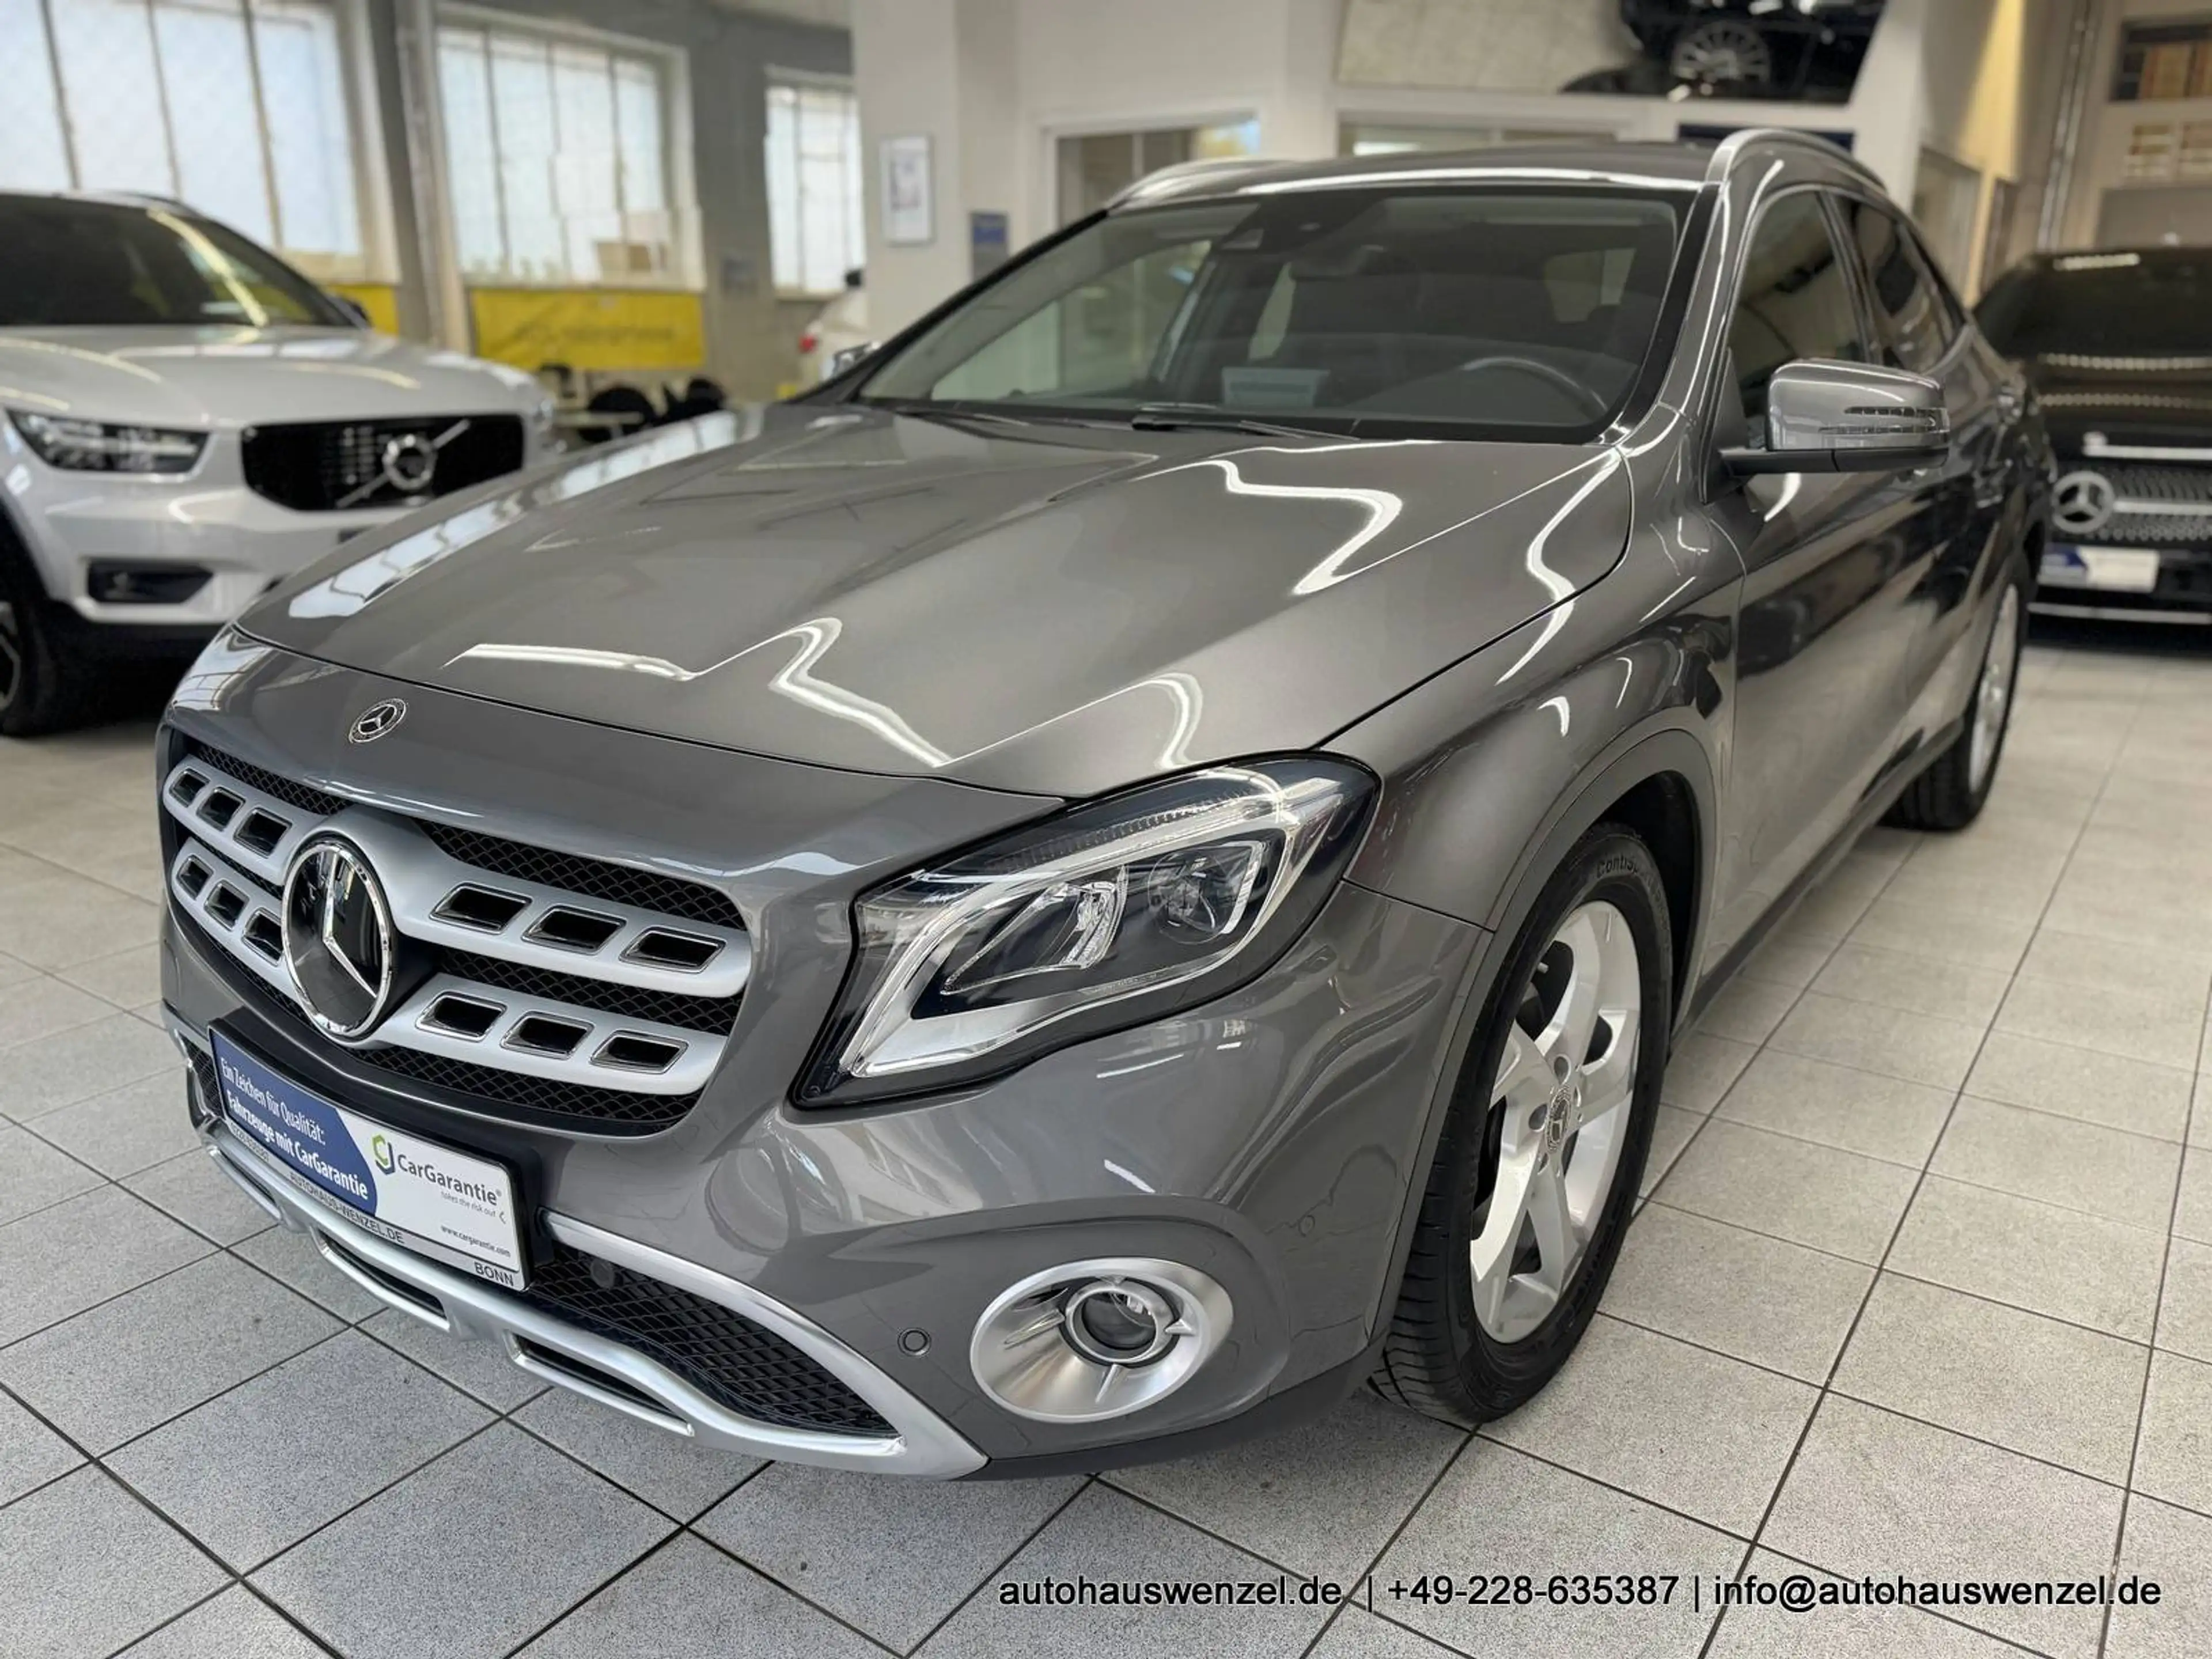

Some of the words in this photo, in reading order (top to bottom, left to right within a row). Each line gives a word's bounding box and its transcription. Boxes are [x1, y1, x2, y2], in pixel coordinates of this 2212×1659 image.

[221, 1056, 235, 1084] Ein
[233, 1067, 266, 1108] Zeichen
[266, 1090, 281, 1118] für
[281, 1101, 326, 1146] Qualität:
[227, 1089, 275, 1143] Fahrzeuge
[275, 1131, 295, 1157] mit
[294, 1141, 369, 1200] CarGarantie
[474, 1262, 514, 1286] BONN
